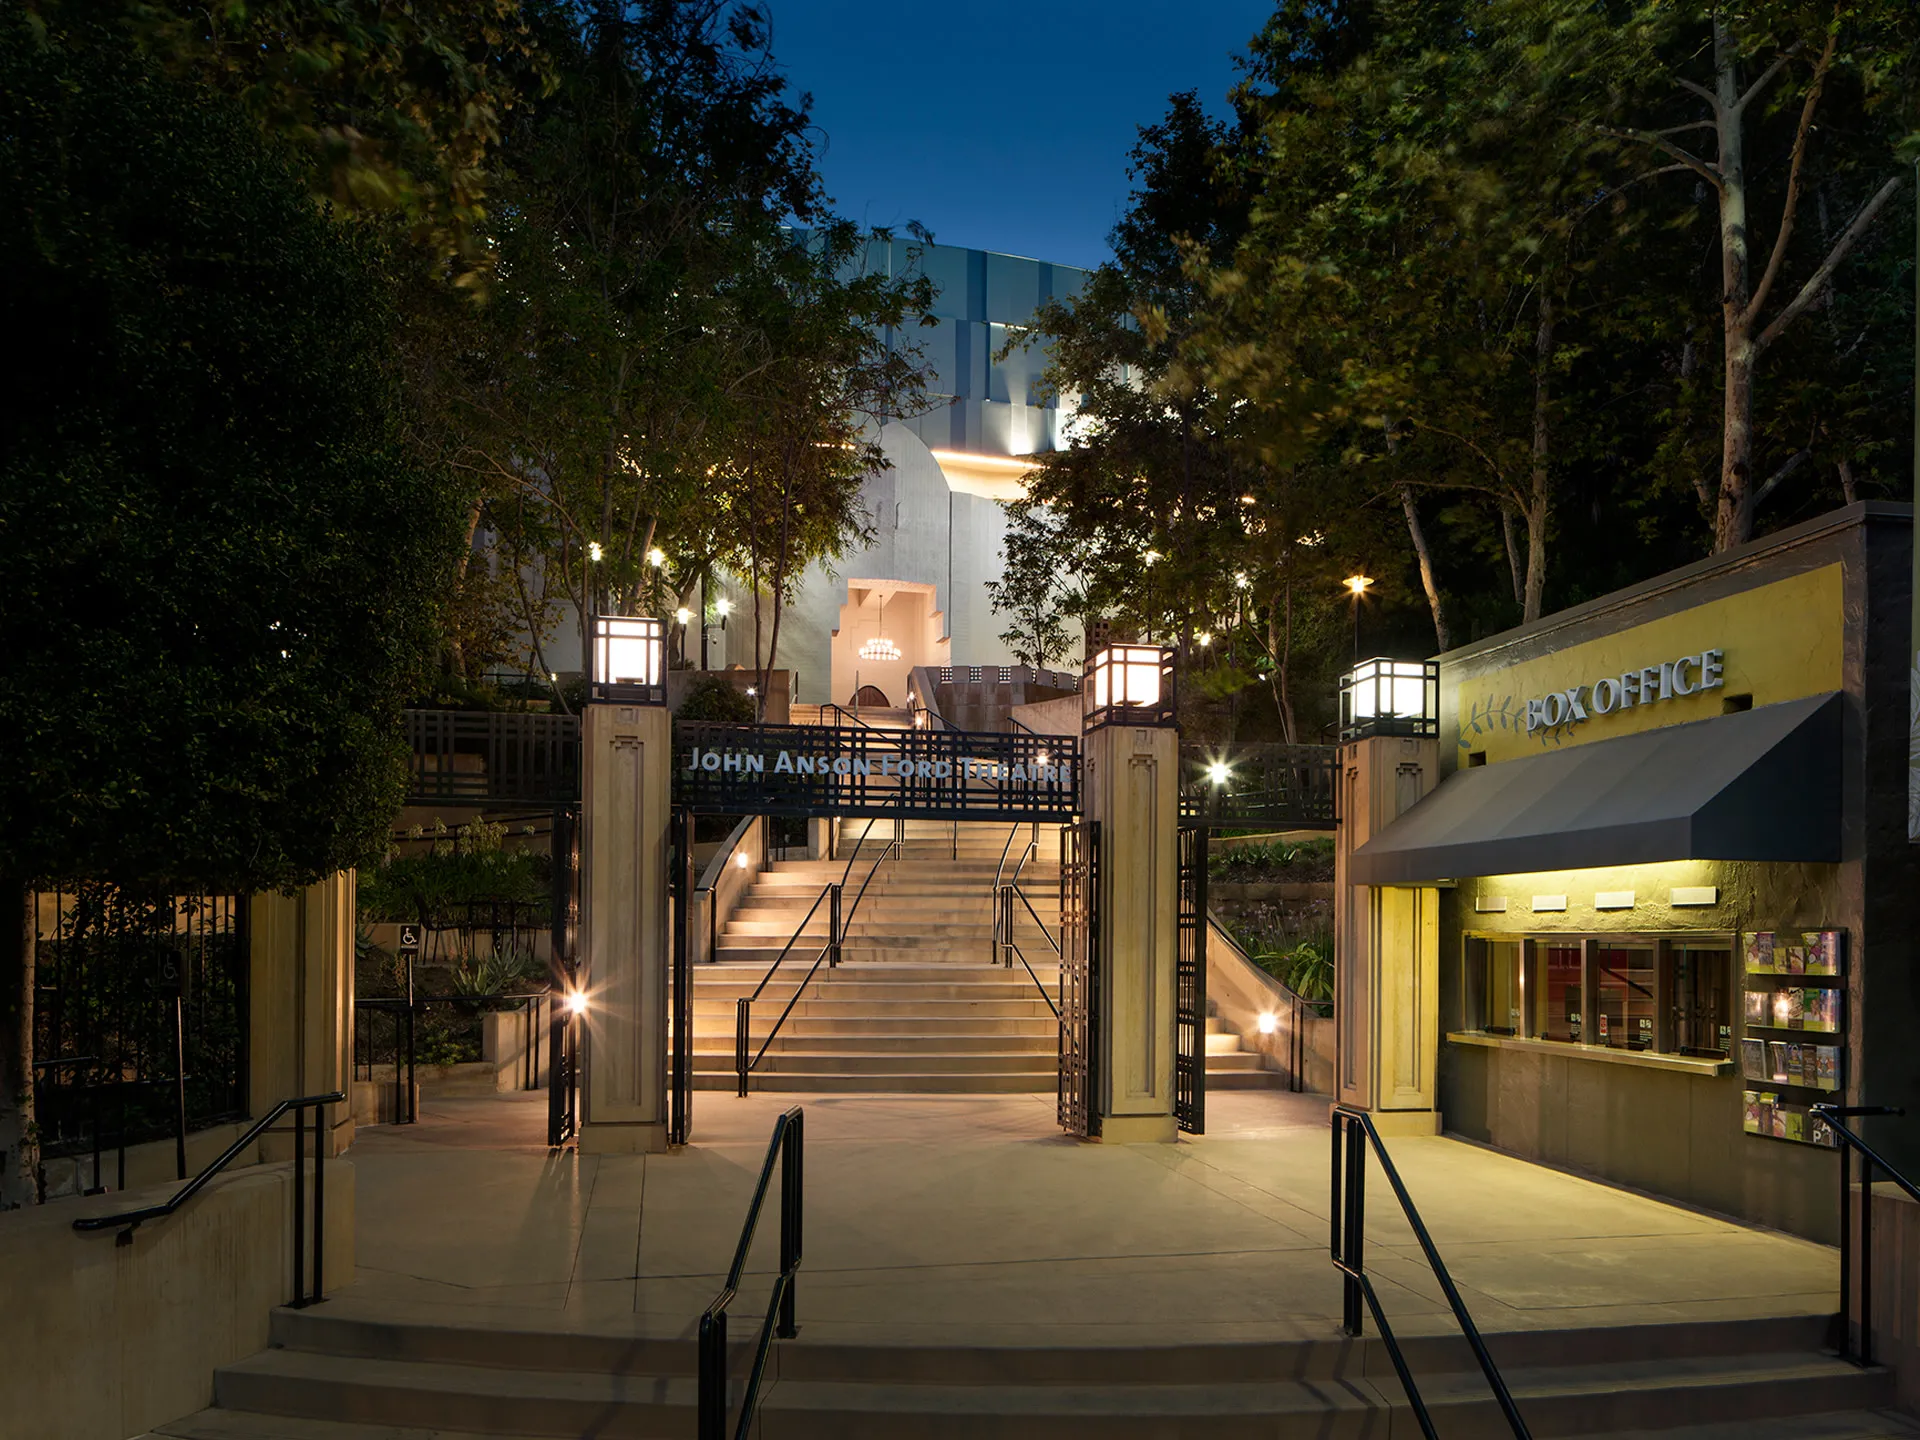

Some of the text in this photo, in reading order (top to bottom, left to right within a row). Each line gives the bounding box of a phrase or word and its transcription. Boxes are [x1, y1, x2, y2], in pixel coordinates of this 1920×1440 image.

[1526, 648, 1724, 732] BOX OFFICE
[688, 746, 1073, 783] JOHN ANSON FORD THEATRE
